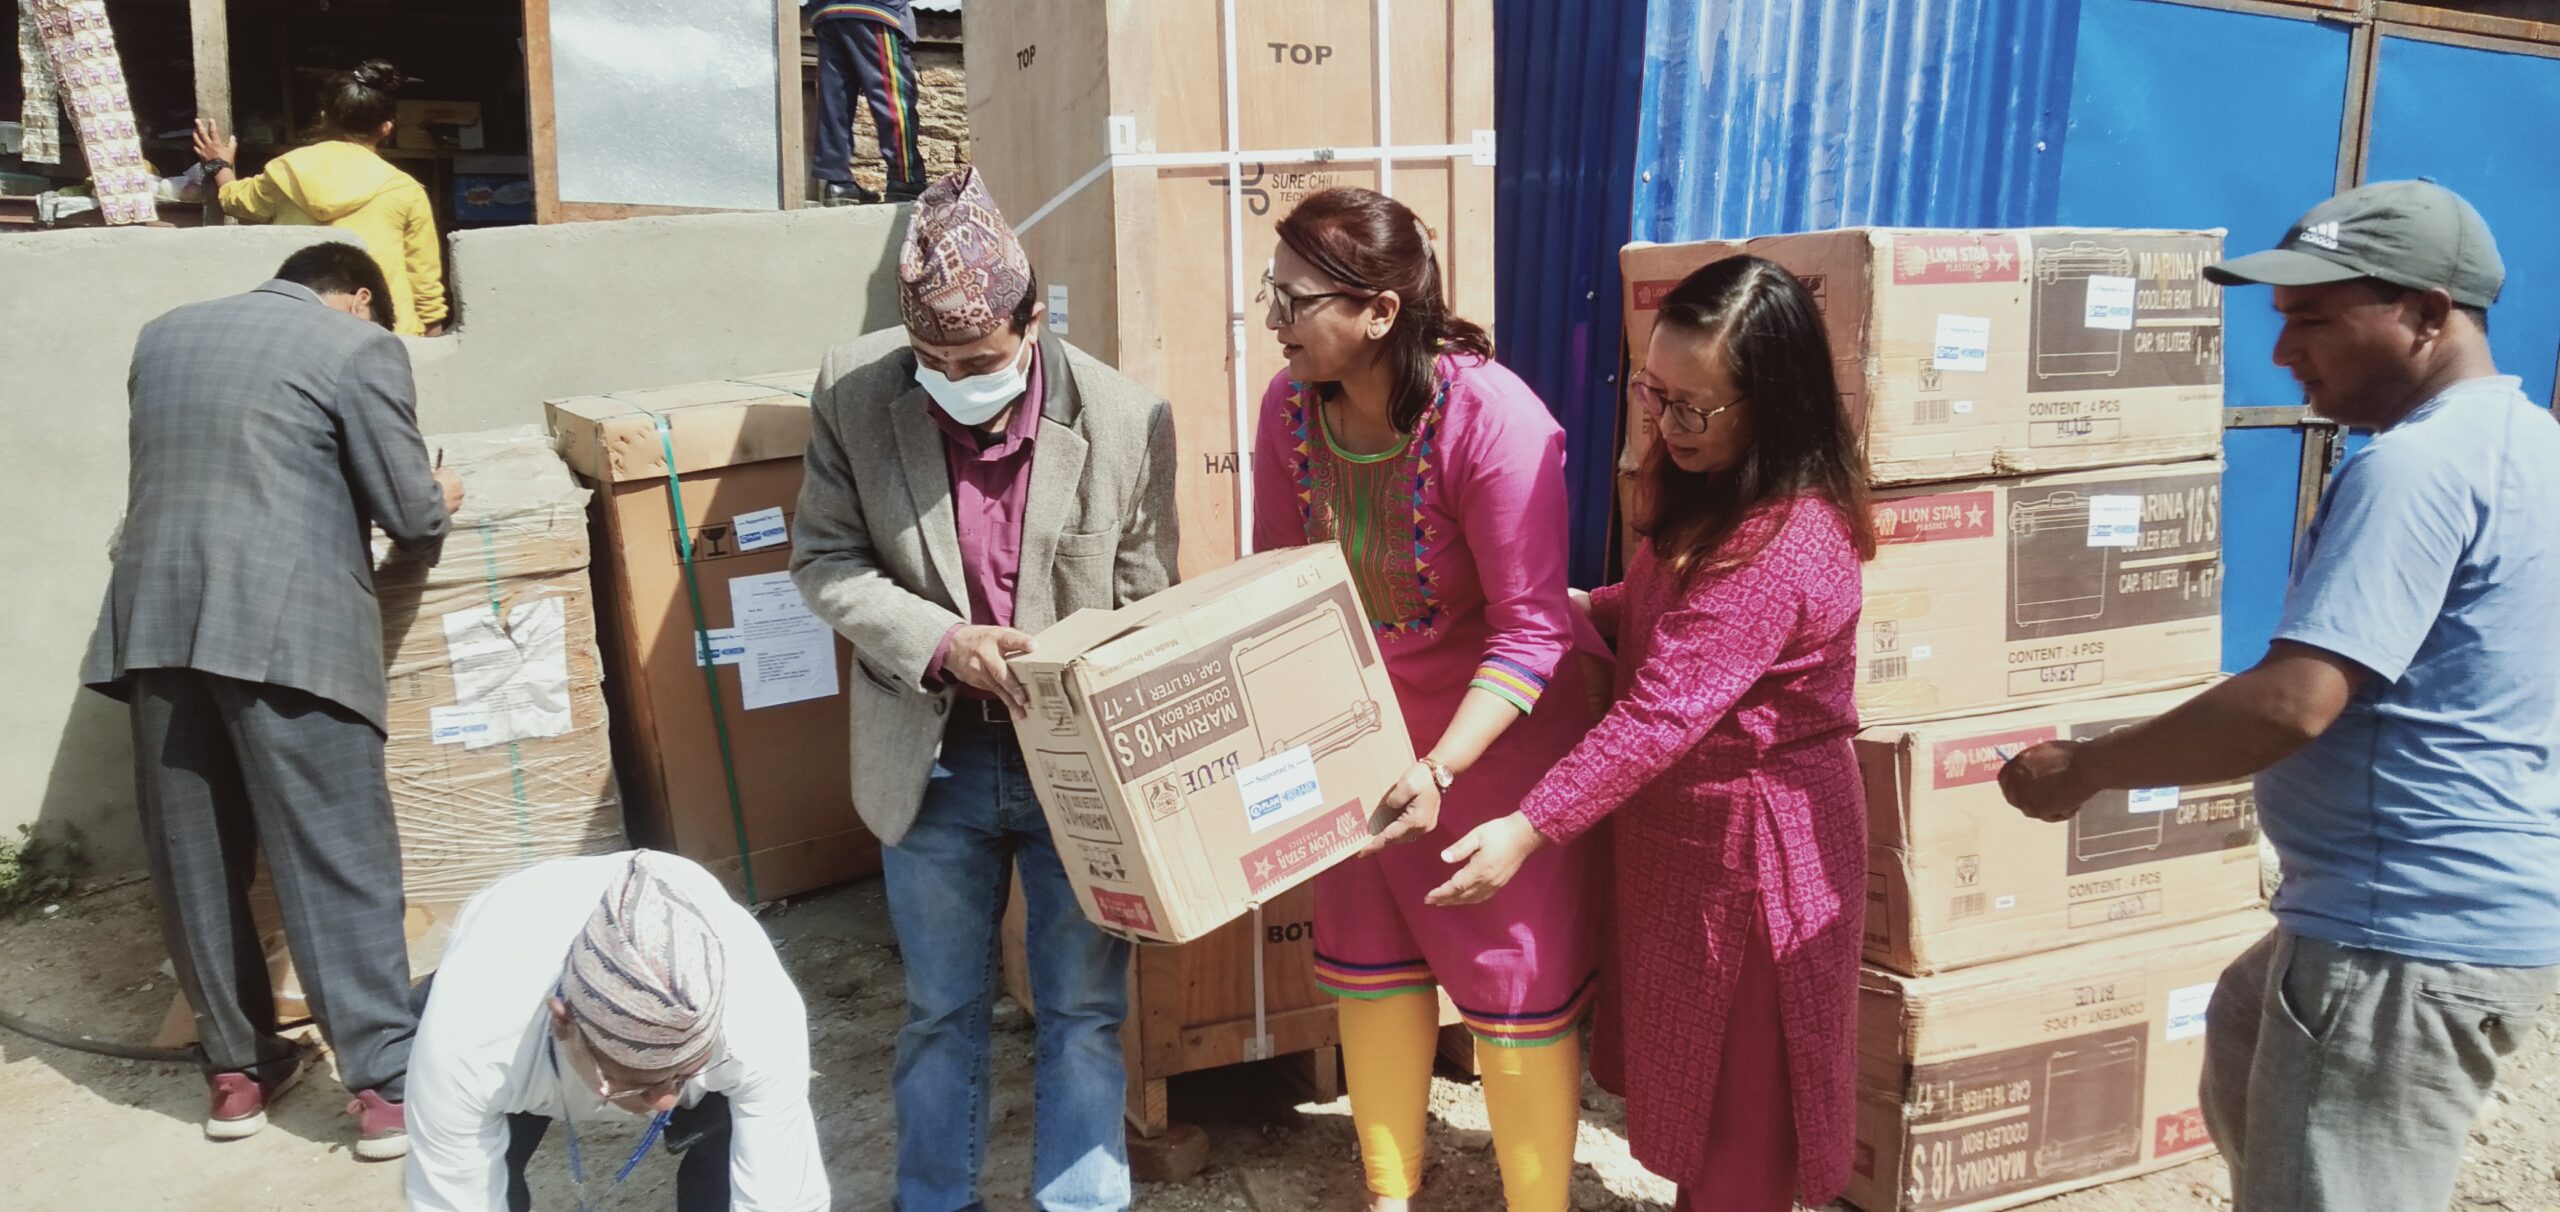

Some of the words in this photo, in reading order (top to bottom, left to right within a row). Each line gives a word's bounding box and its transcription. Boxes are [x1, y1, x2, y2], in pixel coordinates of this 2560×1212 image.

[1017, 45, 1035, 70] TOP
[1267, 43, 1332, 65] TOP
[1272, 173, 1305, 189] SURE
[1929, 246, 1957, 262] LION
[2139, 252, 2195, 280] MARINA
[2137, 289, 2173, 310] COOLER
[2174, 289, 2192, 310] BOX
[2029, 401, 2080, 416] CONTENT
[2099, 400, 2120, 413] PCS
[1901, 507, 1929, 524] LION
[1932, 505, 1961, 521] STAR
[2186, 487, 2204, 543] 18
[2008, 646, 2062, 664] CONTENT
[2081, 642, 2104, 655] PCS
[1183, 671, 1196, 687] 16
[1197, 660, 1221, 680] CAP.
[1149, 678, 1182, 701] LITER
[1184, 686, 1230, 716] COOLER
[1104, 698, 1123, 721] 17
[1158, 707, 1185, 727] BOX
[1161, 702, 1238, 748] MARINA
[1114, 732, 1135, 767] S
[1134, 719, 1163, 758] 18
[1968, 745, 1996, 765] LION
[1181, 750, 1240, 795] BLUE
[1309, 831, 1336, 853] LION
[1277, 846, 1307, 869] STAR
[2068, 878, 2121, 898] CONTENT
[2140, 872, 2160, 886] PCS
[2089, 1002, 2145, 1024] CONTENT
[1961, 1131, 1985, 1156] BOX
[1986, 1121, 2029, 1150] COOLER
[1931, 1140, 1954, 1201] 18
[1956, 1150, 2027, 1192] MARINA
